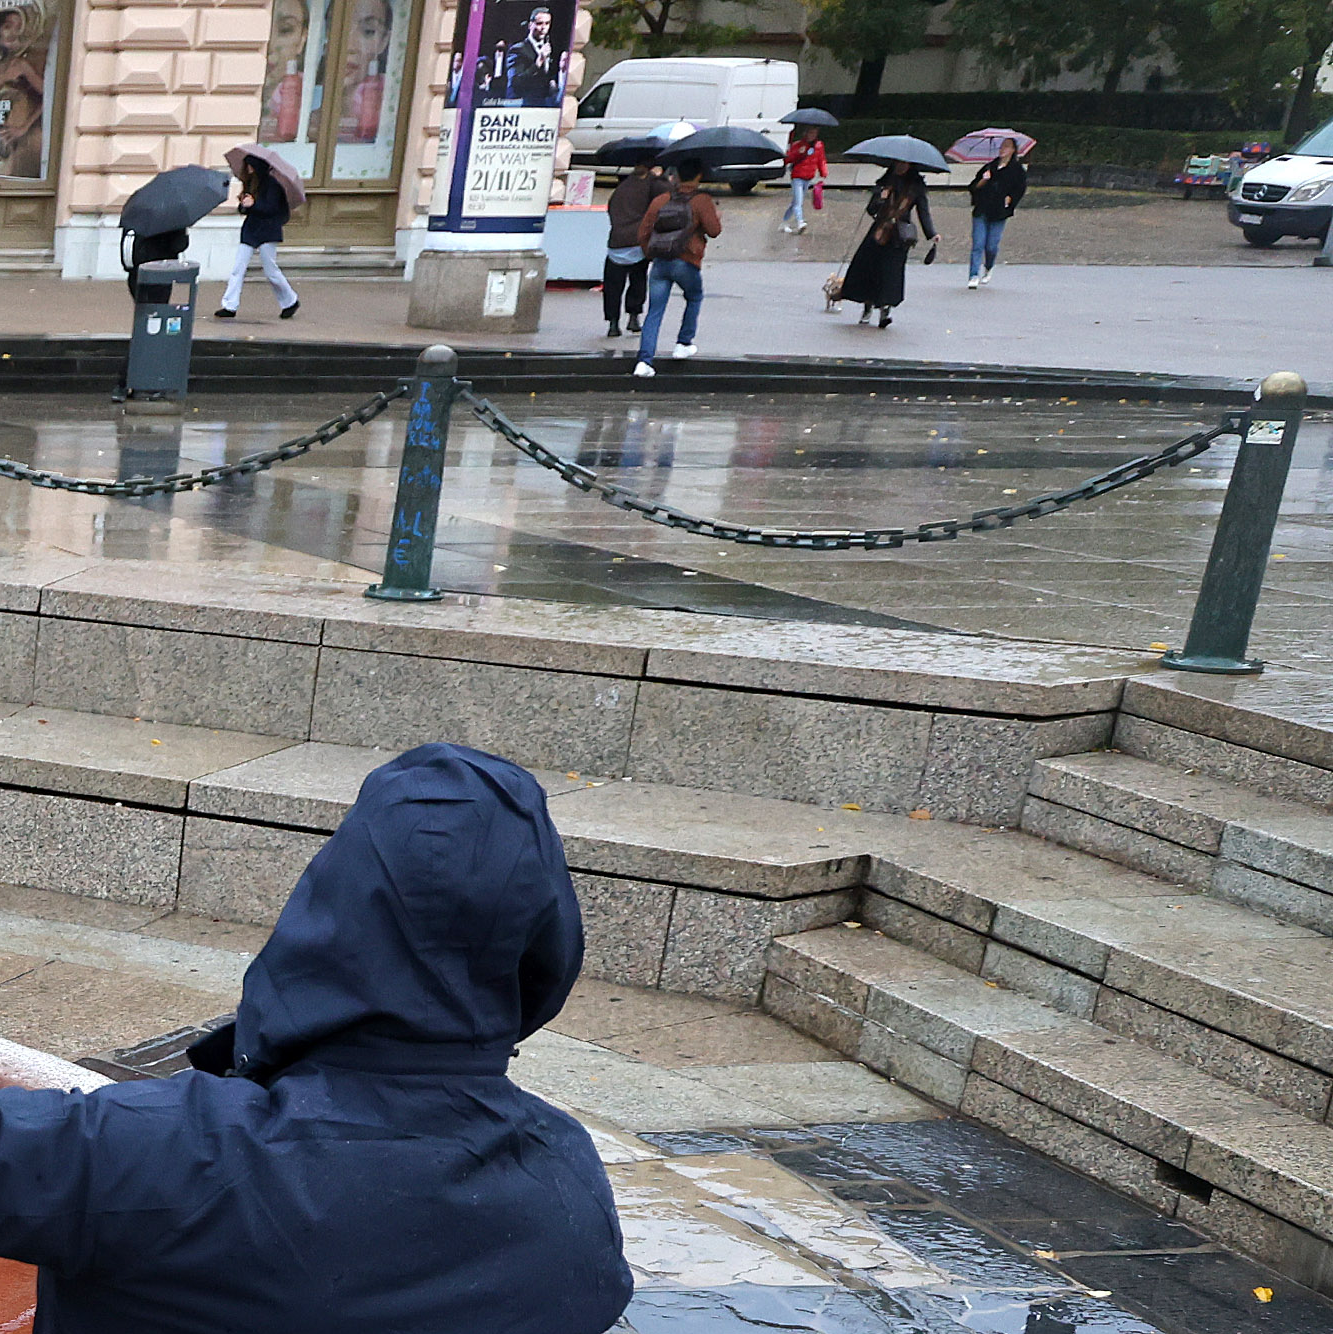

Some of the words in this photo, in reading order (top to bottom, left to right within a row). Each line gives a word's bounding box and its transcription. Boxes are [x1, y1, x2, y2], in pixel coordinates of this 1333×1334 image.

[474, 152, 496, 165] MY
[499, 152, 530, 165] WAY
[471, 168, 538, 192] 21/11/25
